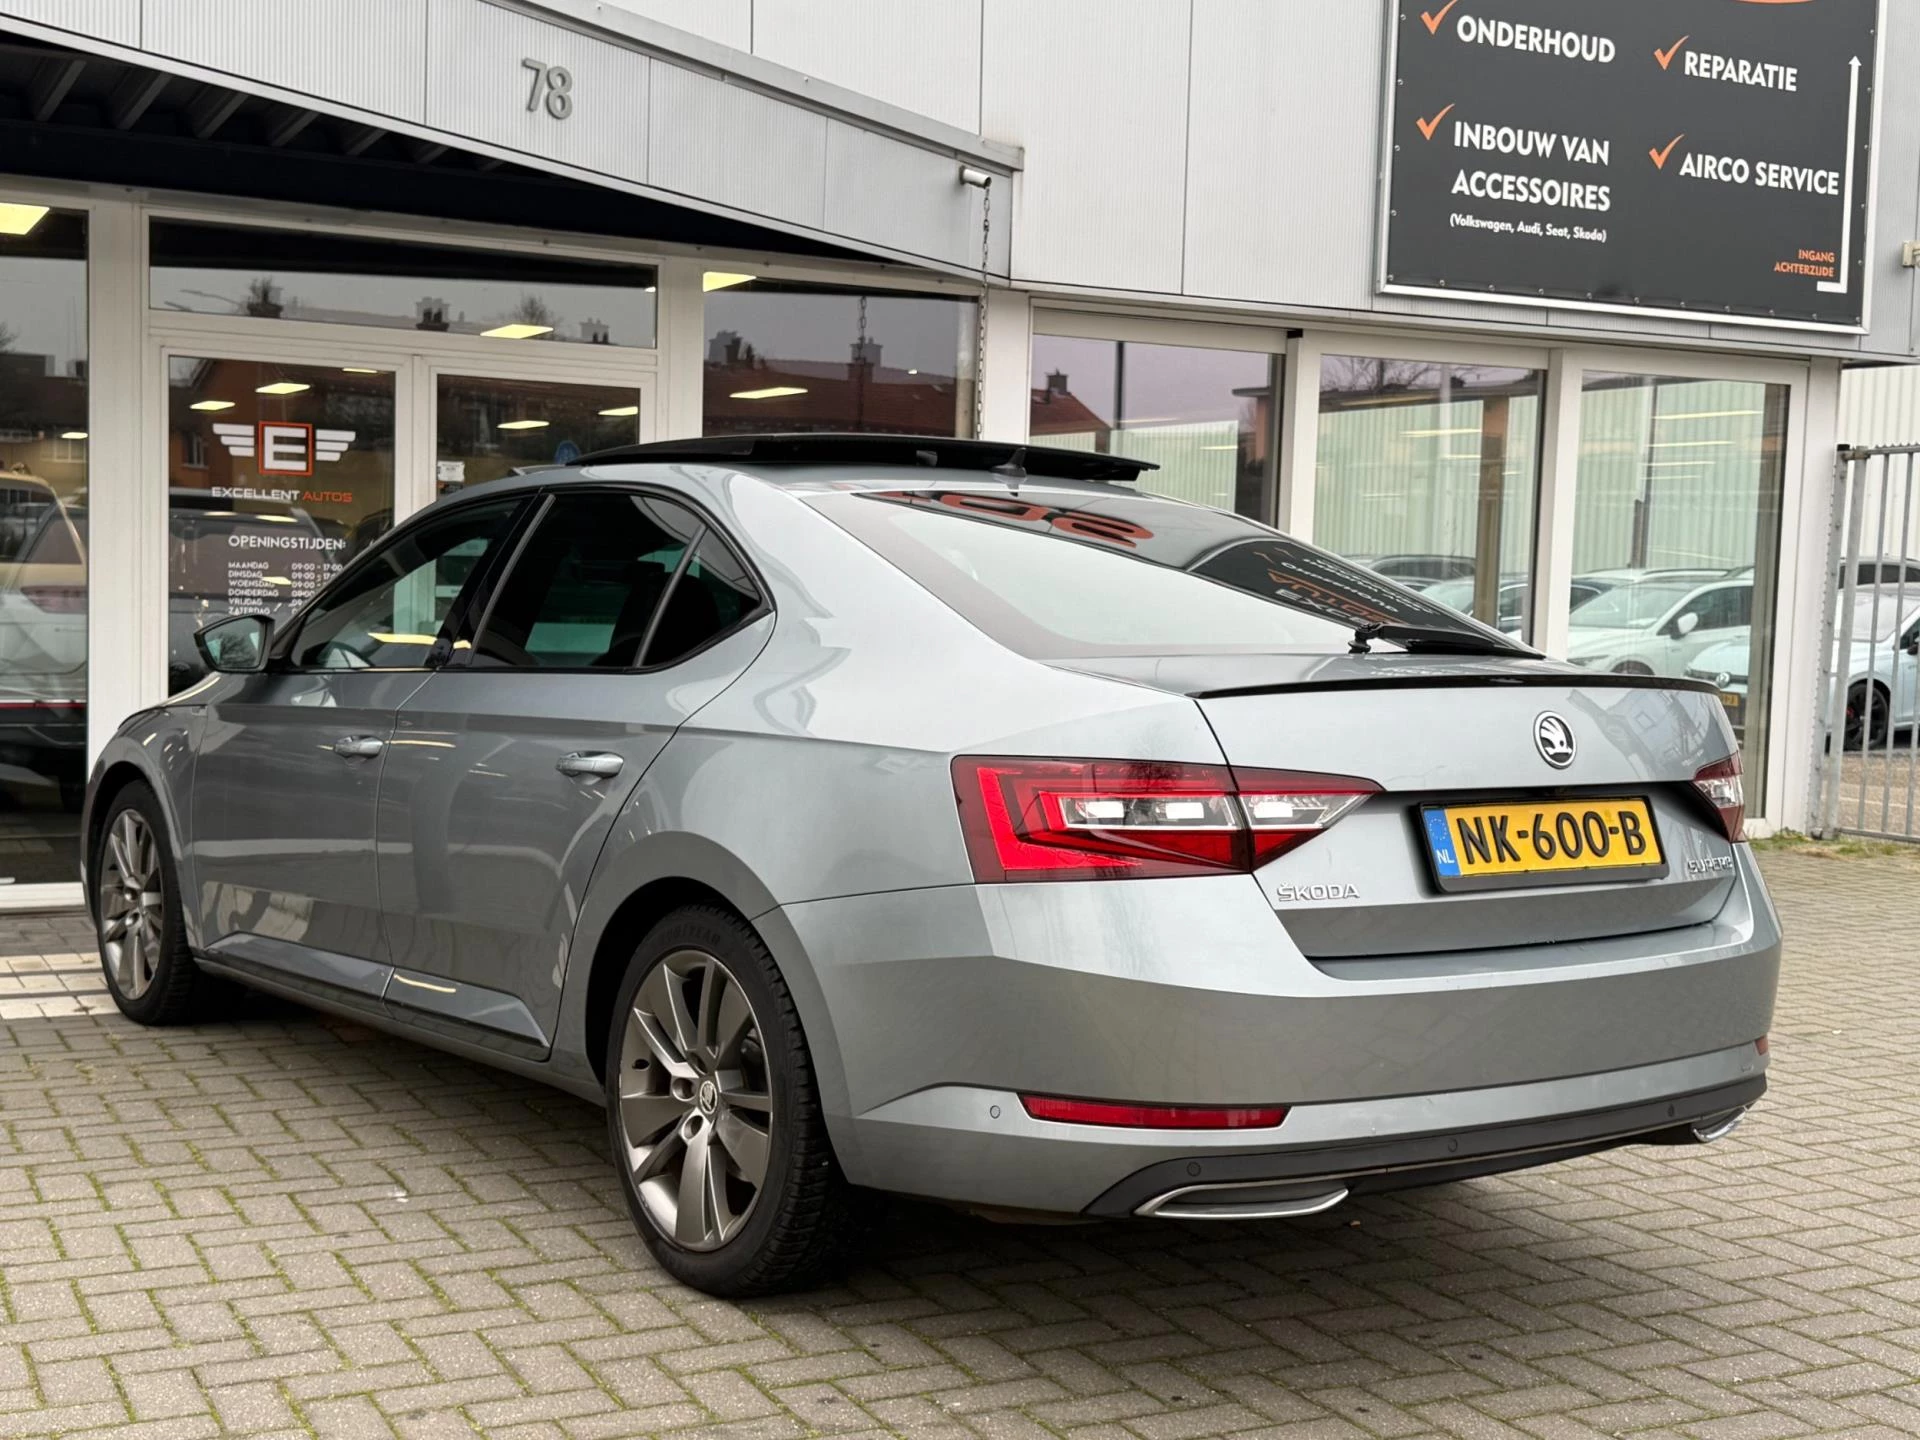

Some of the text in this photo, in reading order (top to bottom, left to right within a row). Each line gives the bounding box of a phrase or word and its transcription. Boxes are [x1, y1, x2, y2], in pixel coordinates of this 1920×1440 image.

[1457, 15, 1616, 63] ONDERHOUD
[1684, 50, 1798, 92] REPARATIE
[521, 57, 573, 120] 78
[1454, 120, 1610, 167] INBOUW VAN
[1679, 152, 1840, 195] AIRCO SERVICE
[1451, 169, 1611, 212] ACCESSOIRES
[1450, 212, 1608, 243] (Volkswagen, Audi, Seat, Skoda)
[1798, 249, 1835, 263] INGANG
[1774, 262, 1835, 277] ACHTERZIJDE
[264, 426, 307, 470] E
[211, 487, 353, 503] EXCELLENT AUTOS
[228, 535, 347, 550] OPENINGSTIJDEN:
[228, 561, 269, 570] MAANDAG
[228, 570, 263, 578] DINSDAG
[228, 579, 275, 588] WOENSDAG
[228, 588, 279, 597] DONDERDAG
[228, 597, 263, 606] VRIJDAG
[228, 606, 271, 615] ZATERDAG
[1436, 810, 1647, 865] NL NK-600-B
[1277, 882, 1360, 902] ŠKODA
